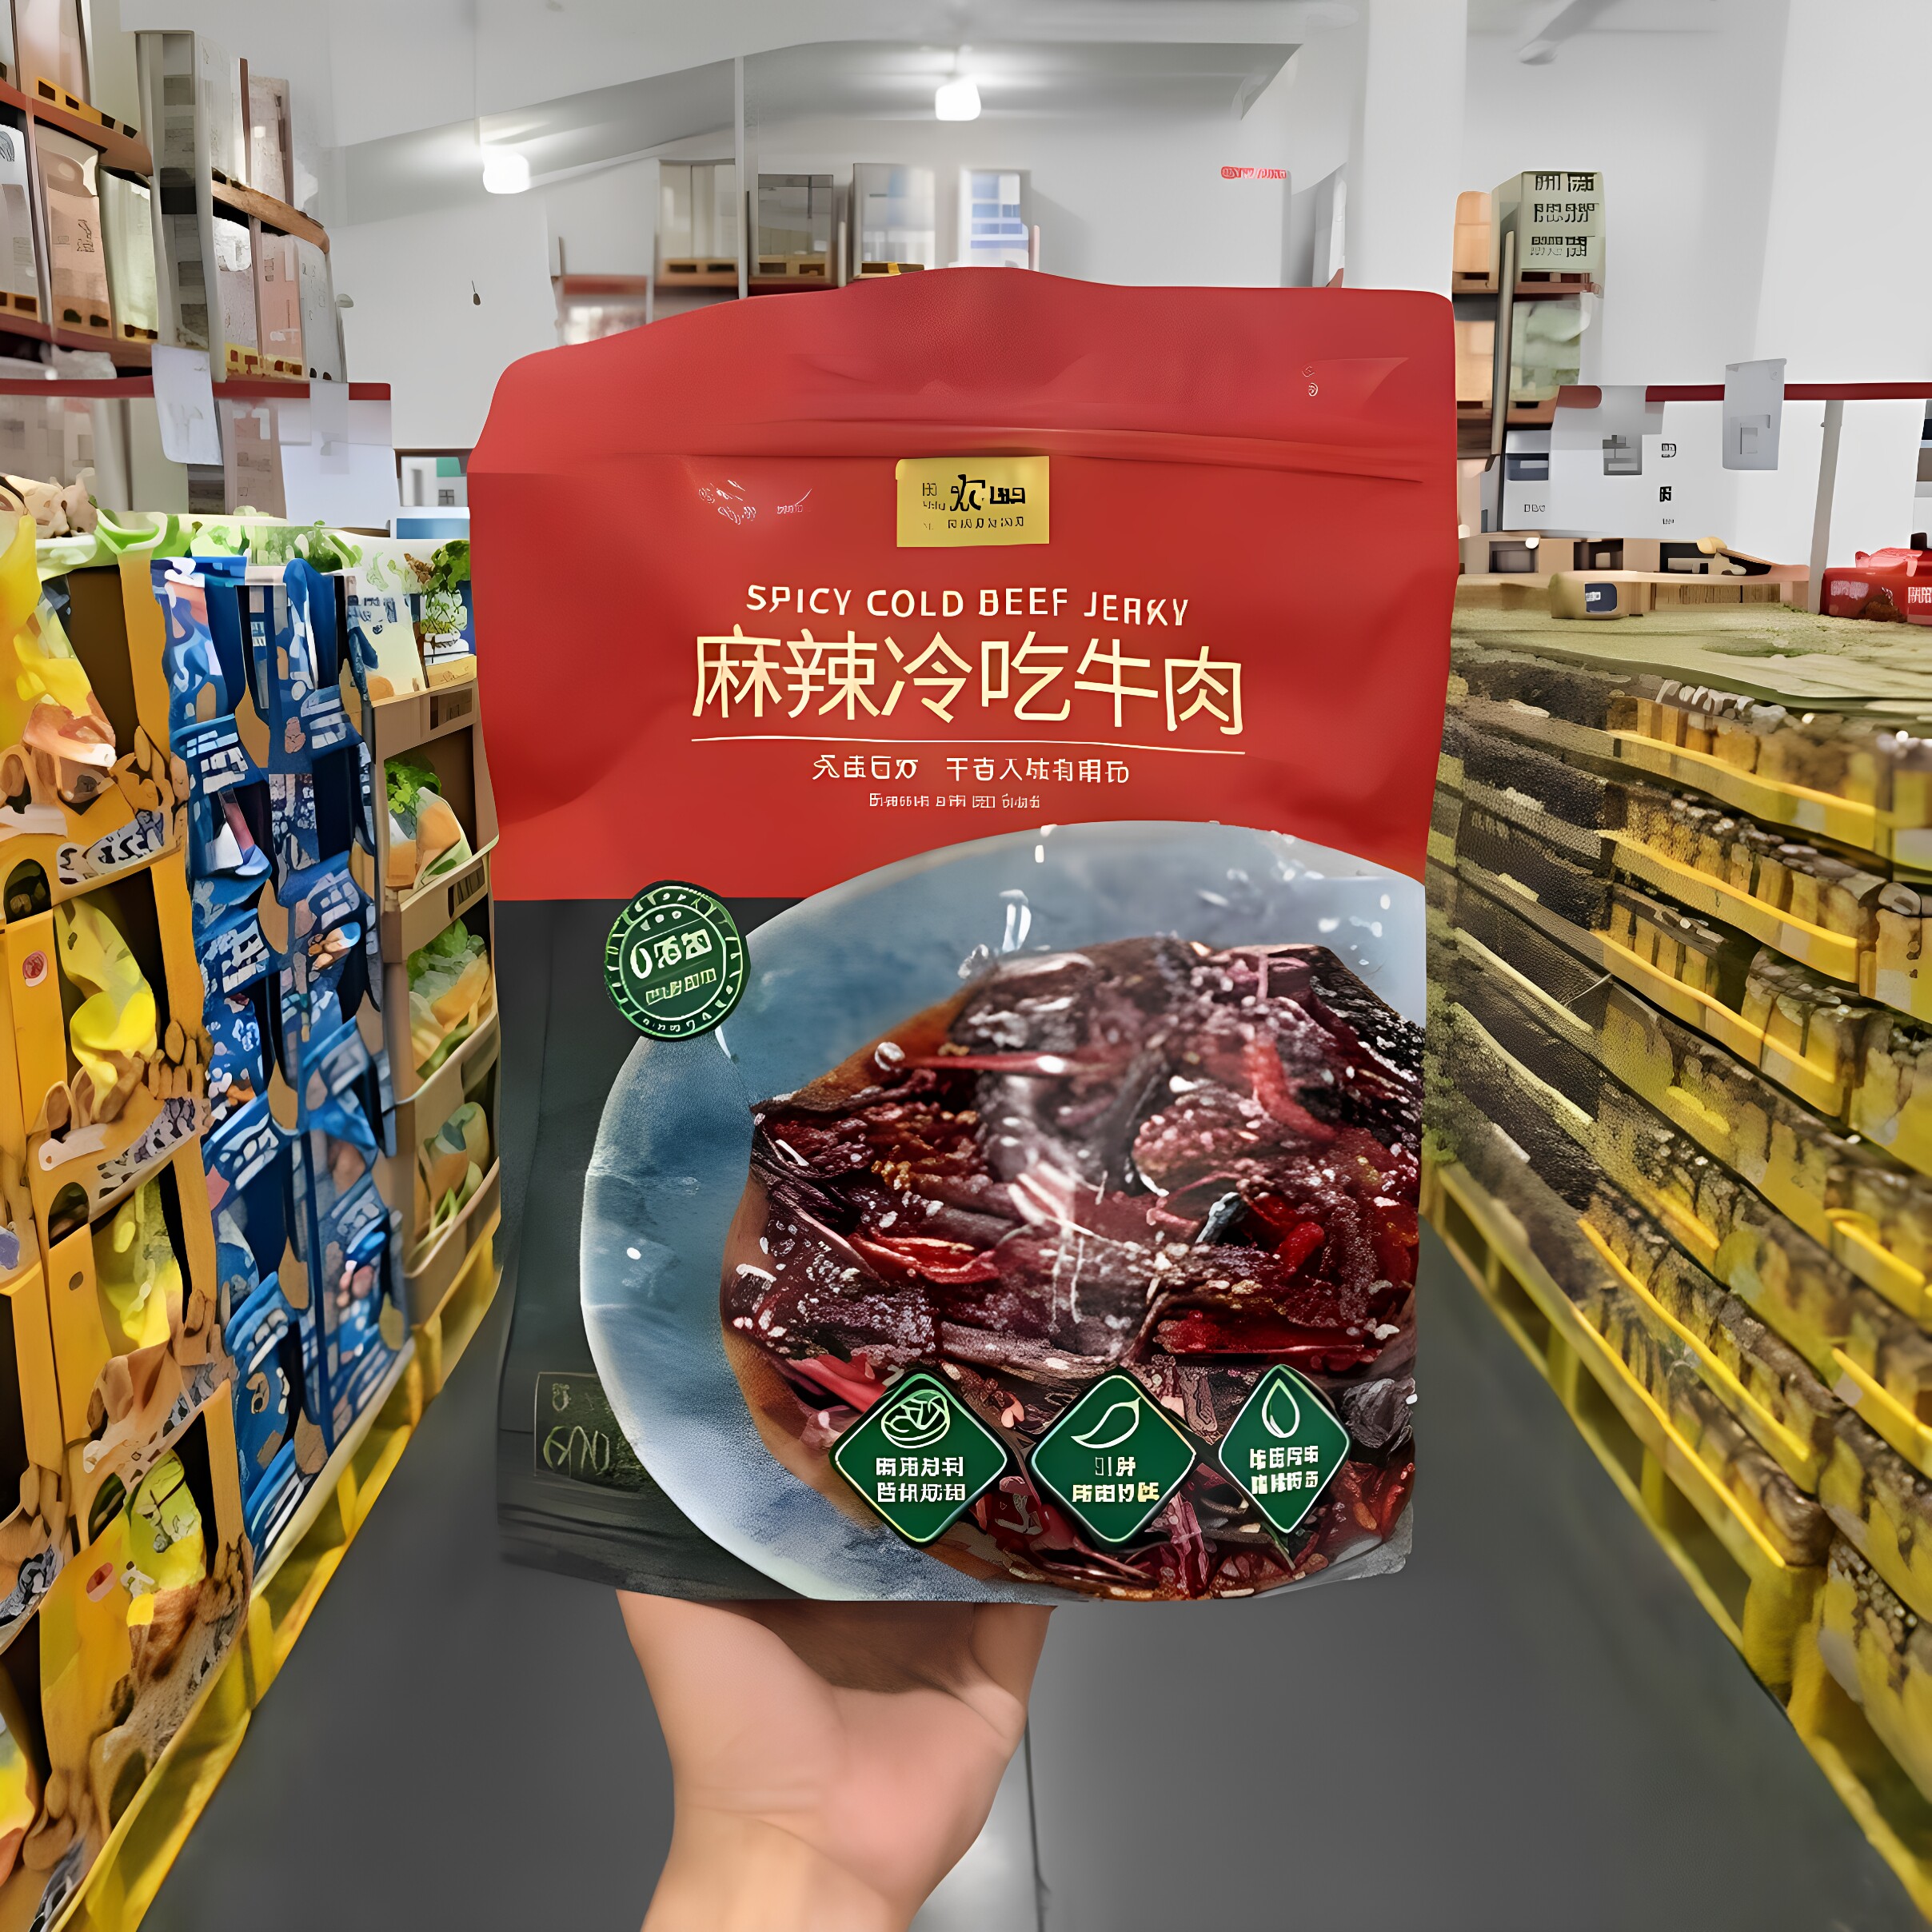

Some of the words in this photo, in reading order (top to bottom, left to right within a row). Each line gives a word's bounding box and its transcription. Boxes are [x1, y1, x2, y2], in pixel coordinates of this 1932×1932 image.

[747, 585, 851, 616] SPICY
[867, 589, 964, 618] COLD
[978, 587, 1068, 617] BEEF
[1084, 591, 1189, 626] JERKY
[692, 624, 1245, 735] 麻辣冷吃牛肉
